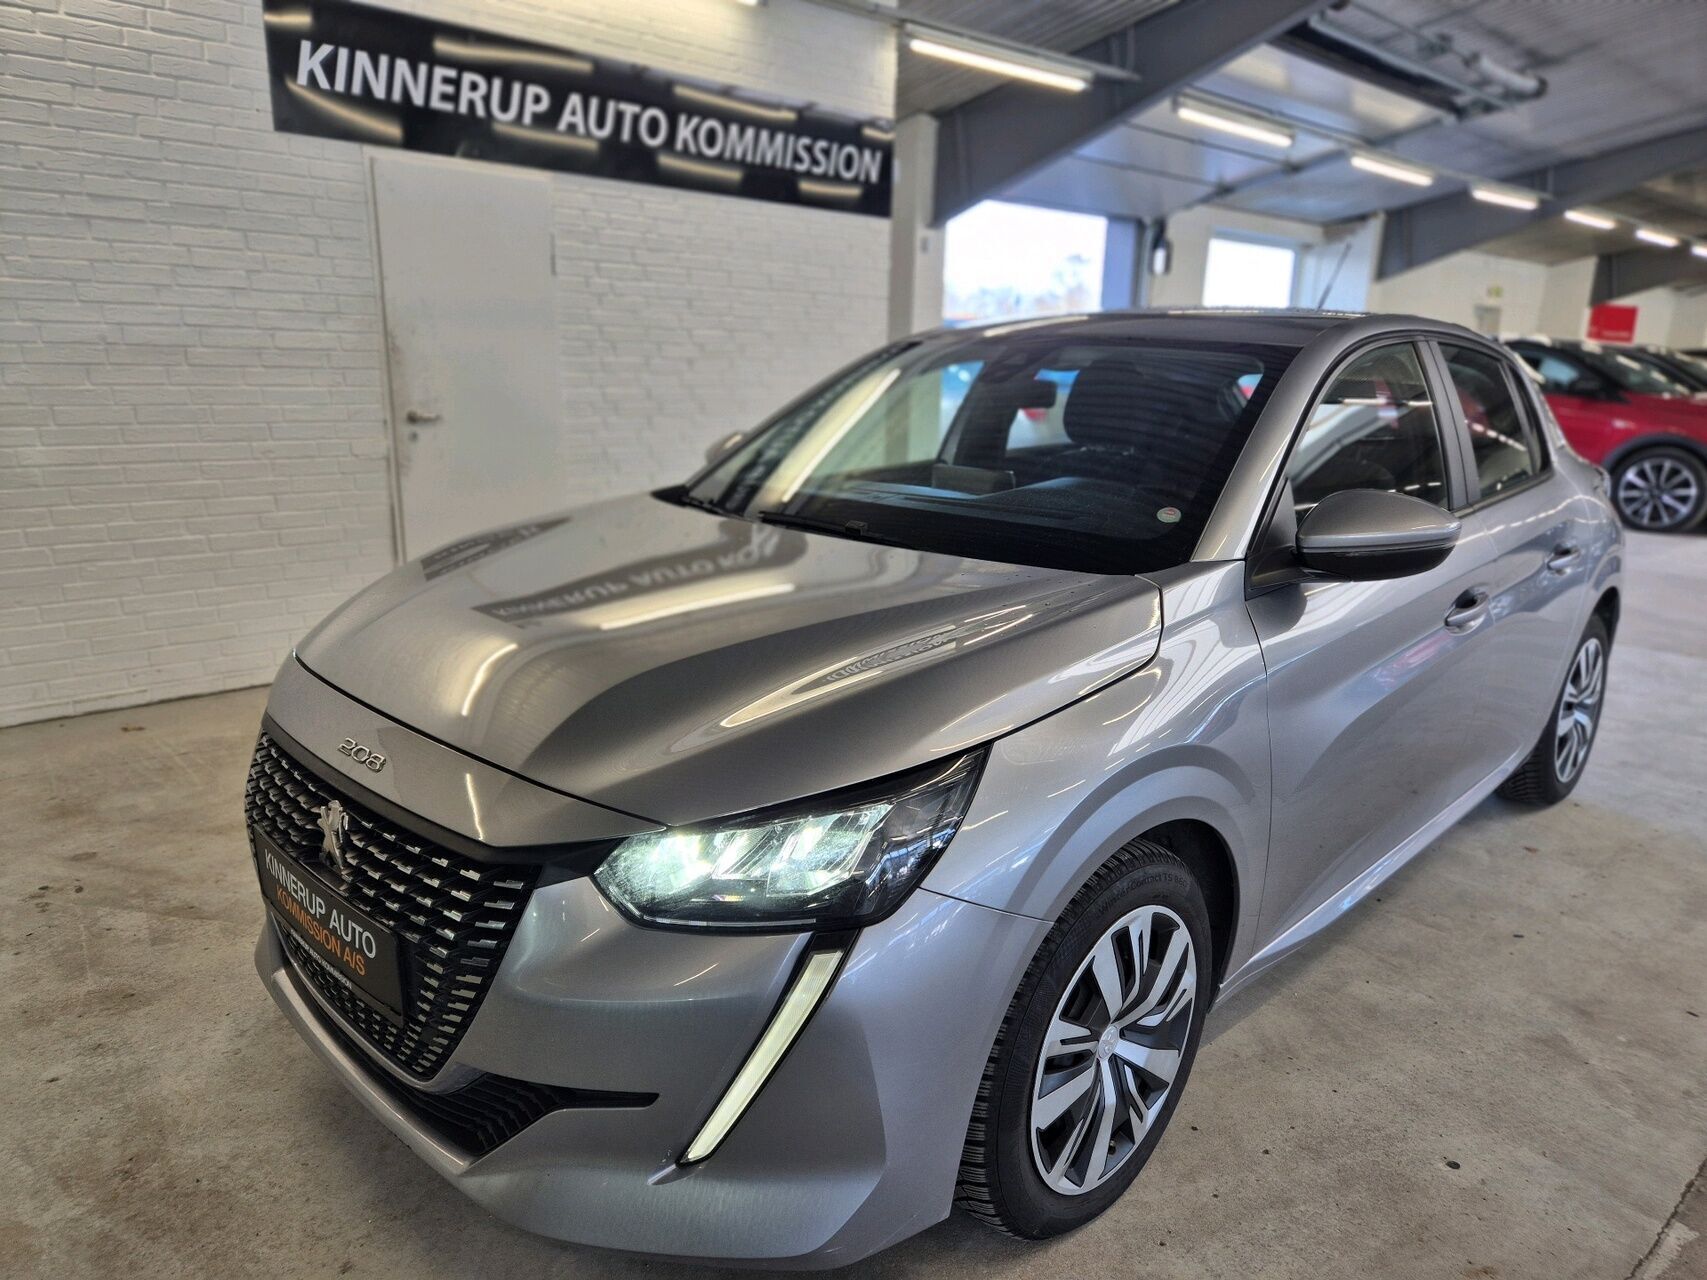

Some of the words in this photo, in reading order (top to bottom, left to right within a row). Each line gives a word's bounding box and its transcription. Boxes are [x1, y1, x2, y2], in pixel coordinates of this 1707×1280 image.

[296, 40, 551, 126] KINNERUP
[557, 94, 669, 147] AUTO
[675, 114, 882, 184] KOMMISSION
[337, 738, 387, 773] 208
[265, 849, 326, 919] KINNERUP
[329, 908, 376, 959] AUTO
[276, 884, 341, 957] KOMMISSION
[343, 946, 366, 977] A/S
